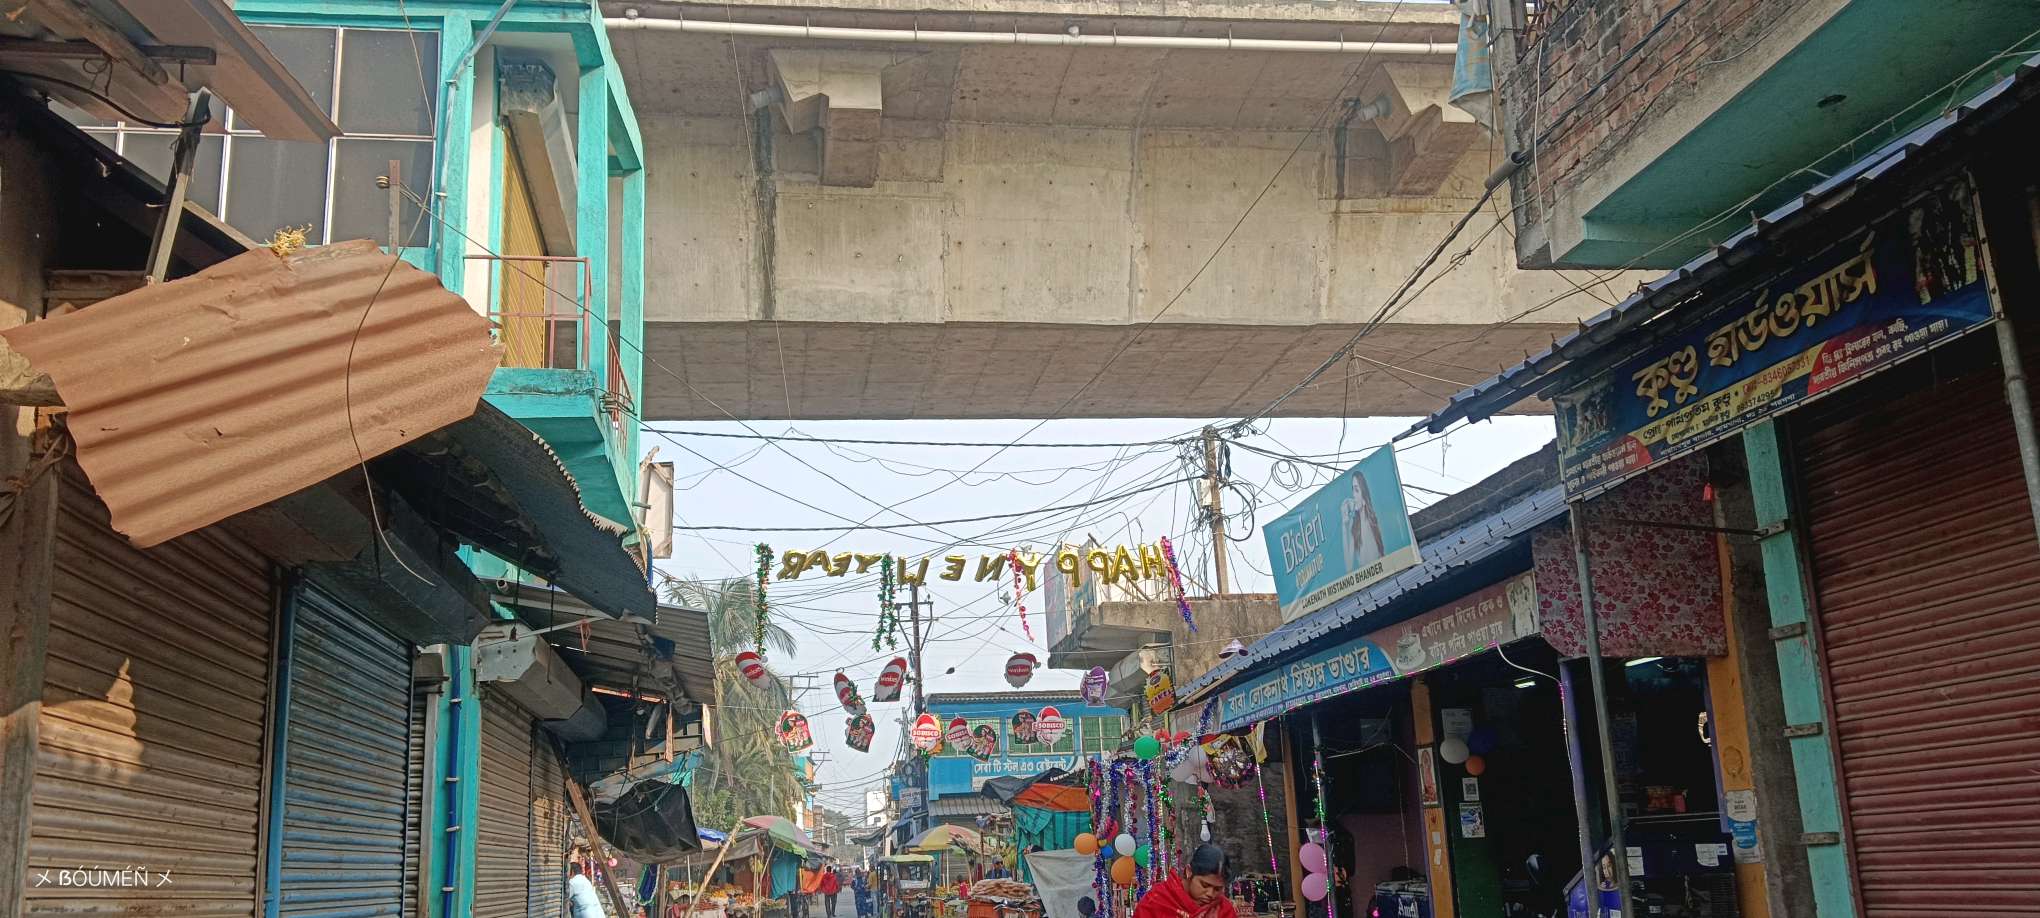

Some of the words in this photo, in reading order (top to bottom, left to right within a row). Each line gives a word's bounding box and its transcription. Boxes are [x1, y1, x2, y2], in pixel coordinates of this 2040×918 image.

[1280, 503, 1326, 575] Bisleri
[1327, 575, 1355, 597] MISTANNO
[1355, 561, 1384, 583] BHANDER
[1229, 691, 1246, 715] বাবা
[1250, 670, 1290, 710] লোকনাথ
[1291, 662, 1327, 694] মিষ্টান্ন
